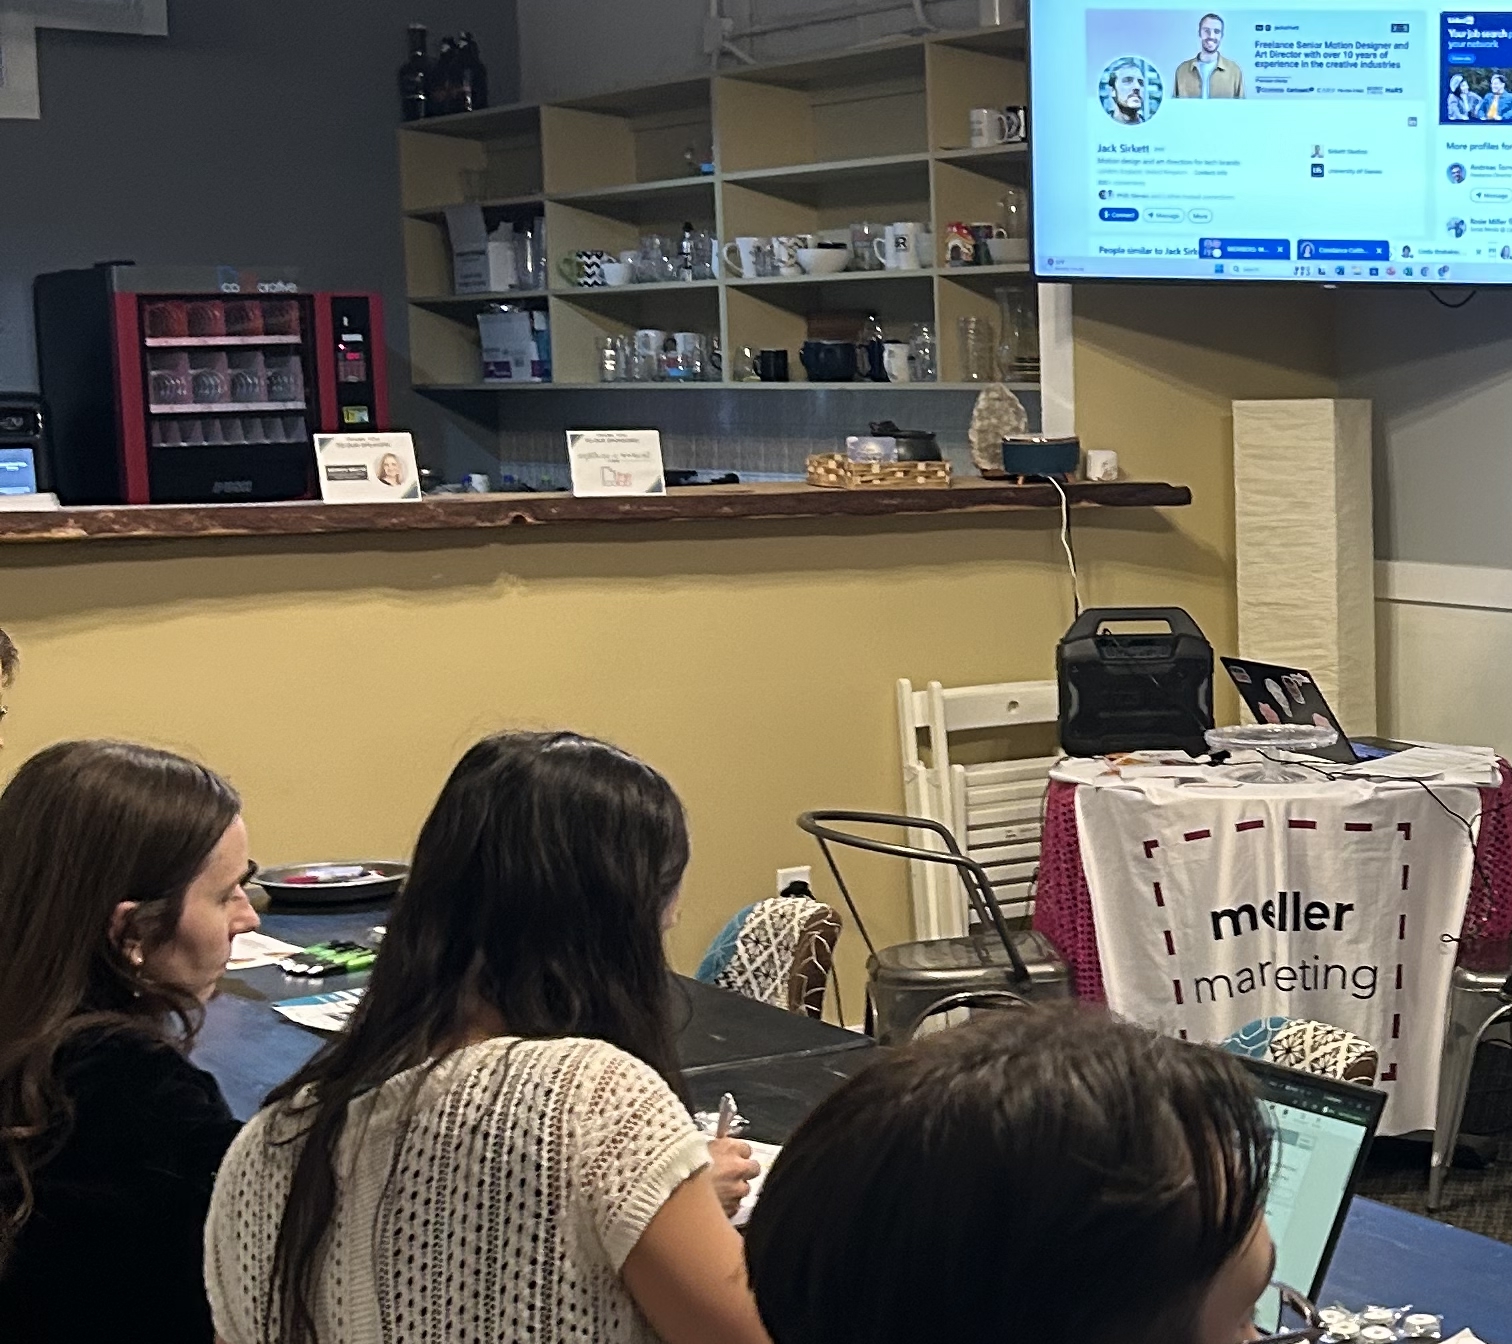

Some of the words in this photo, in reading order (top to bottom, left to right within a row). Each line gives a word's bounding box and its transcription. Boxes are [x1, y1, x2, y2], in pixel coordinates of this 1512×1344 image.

[1255, 40, 1294, 49] Freelance
[1296, 41, 1322, 49] Senior
[1324, 41, 1353, 49] Motion
[1355, 41, 1392, 51] Designer
[1394, 42, 1409, 50] and
[1255, 50, 1268, 58] Art
[1269, 50, 1301, 59] Director
[1303, 50, 1321, 59] with
[1343, 51, 1353, 59] 10
[1355, 52, 1377, 60] years
[1379, 51, 1388, 59] of
[1255, 60, 1299, 69] experience
[1301, 60, 1309, 68] in
[1311, 60, 1324, 68] the
[1325, 60, 1358, 69] creative
[1360, 60, 1400, 69] industries
[1097, 144, 1117, 153] Jack
[1120, 144, 1150, 153] Sirkett
[1446, 142, 1467, 150] More
[1469, 142, 1499, 151] profiles
[1501, 142, 1512, 150] for
[1099, 246, 1125, 255] People
[1127, 246, 1152, 255] similar
[1154, 247, 1163, 255] to
